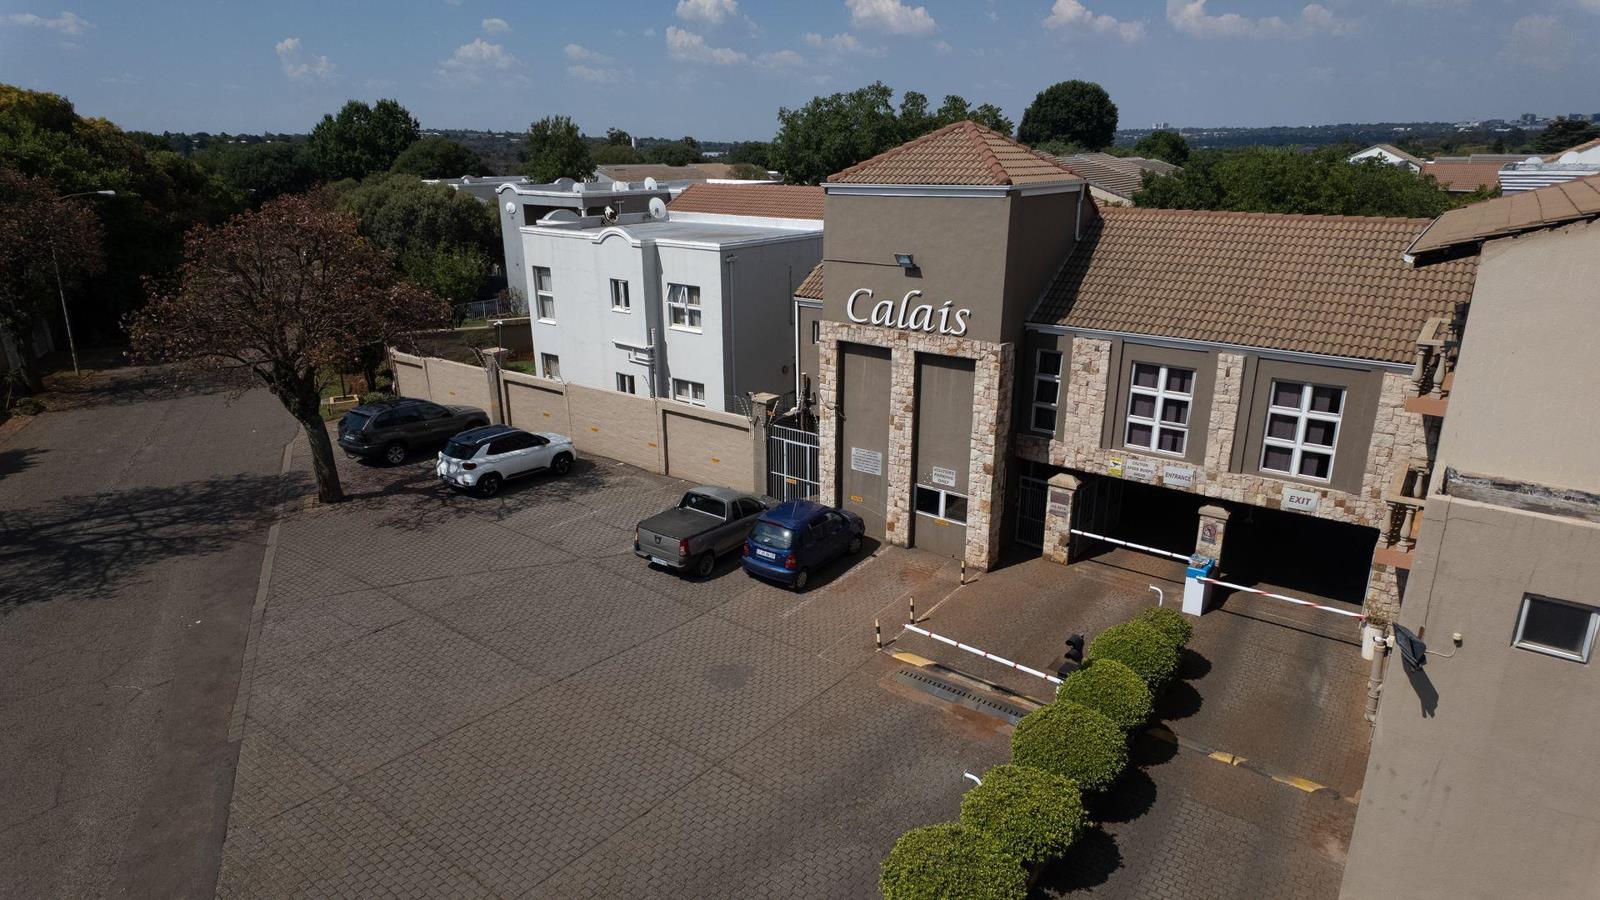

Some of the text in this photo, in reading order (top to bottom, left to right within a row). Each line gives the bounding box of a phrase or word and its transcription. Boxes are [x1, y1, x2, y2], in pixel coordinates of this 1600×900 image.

[846, 288, 971, 336] Calais
[1165, 471, 1192, 482] ENTRANCE
[1288, 495, 1312, 505] EXIT
